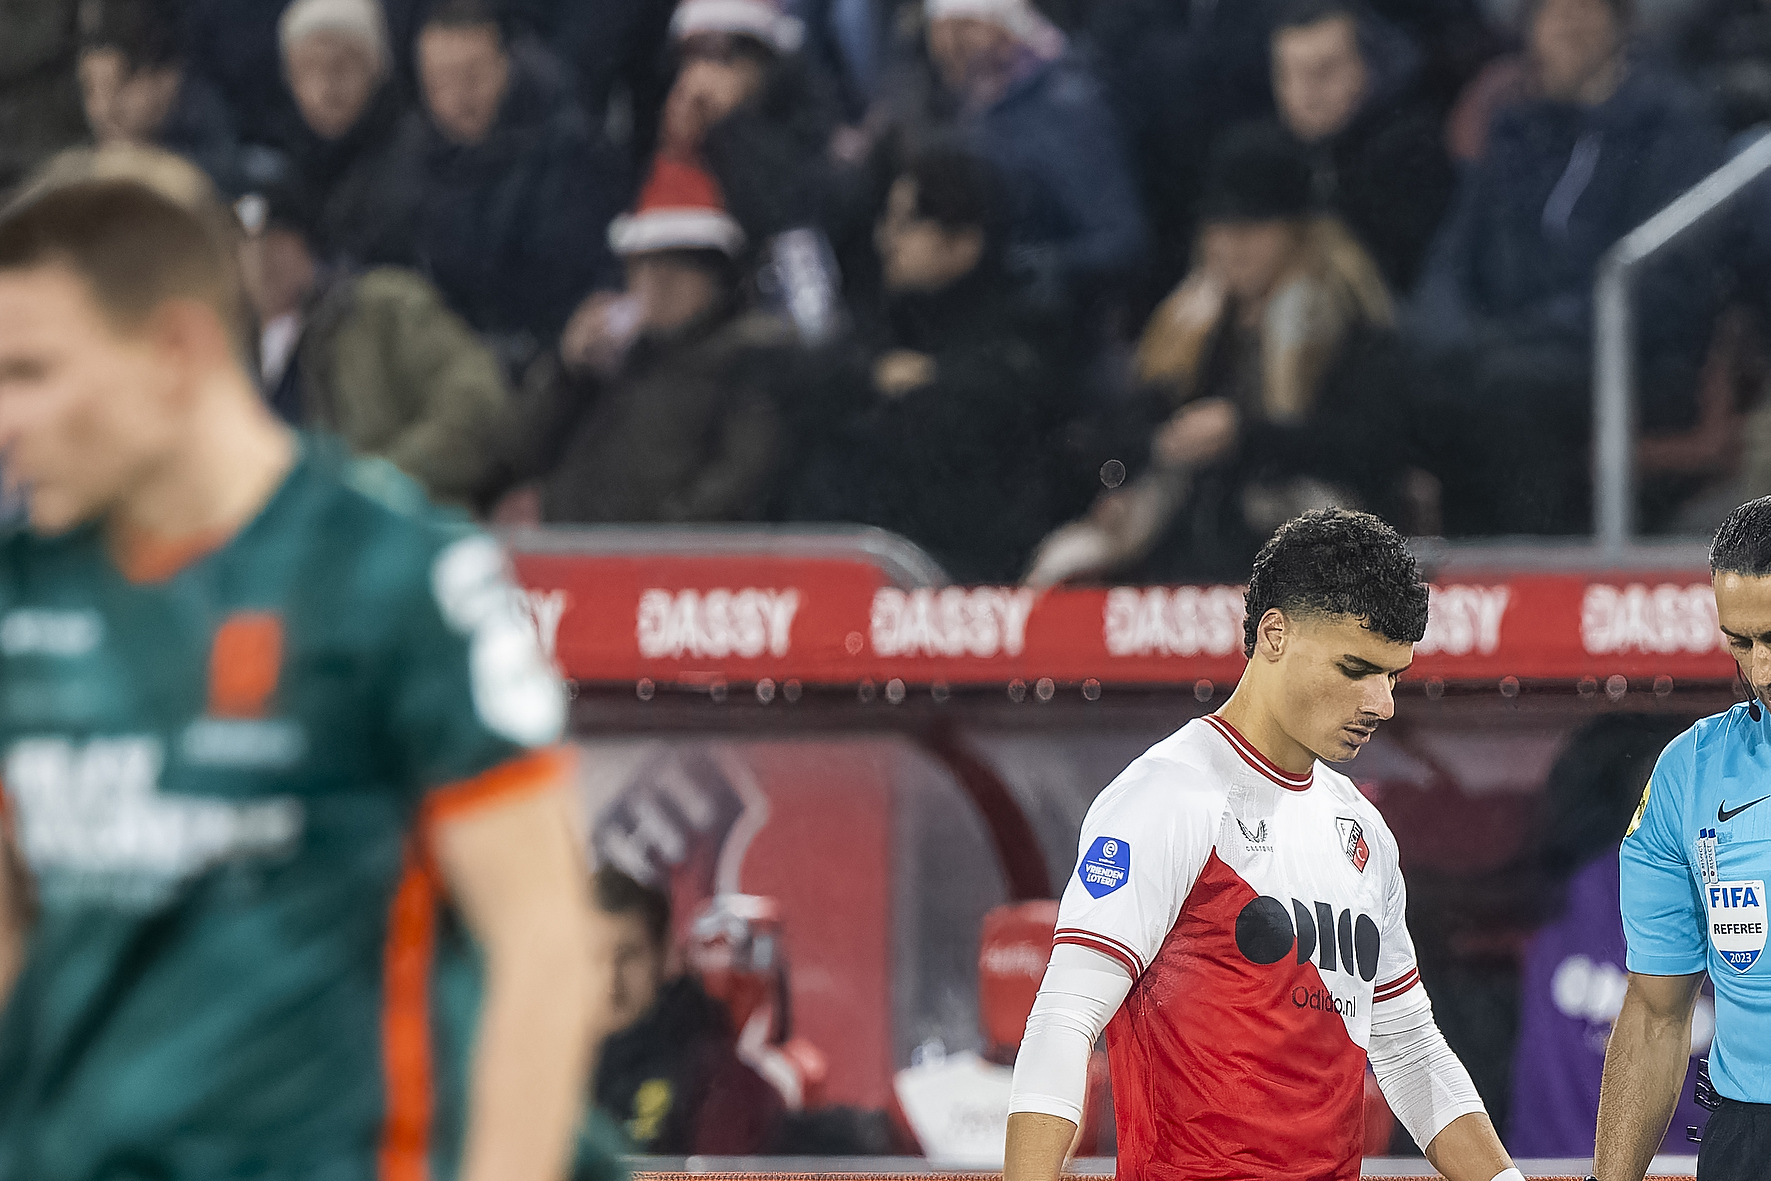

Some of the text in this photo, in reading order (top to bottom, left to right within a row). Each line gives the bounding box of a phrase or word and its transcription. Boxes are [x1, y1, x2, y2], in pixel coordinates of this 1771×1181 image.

[638, 586, 800, 660] DASSY
[868, 585, 1032, 658] DASSY
[1105, 584, 1247, 657] DASS
[1580, 582, 1727, 656] DASS
[1085, 863, 1125, 880] VRIENDEN
[1709, 887, 1760, 908] FIFA
[1713, 922, 1763, 935] REFEREE
[1730, 952, 1752, 963] 2023
[1292, 986, 1357, 1018] Odido.nl
